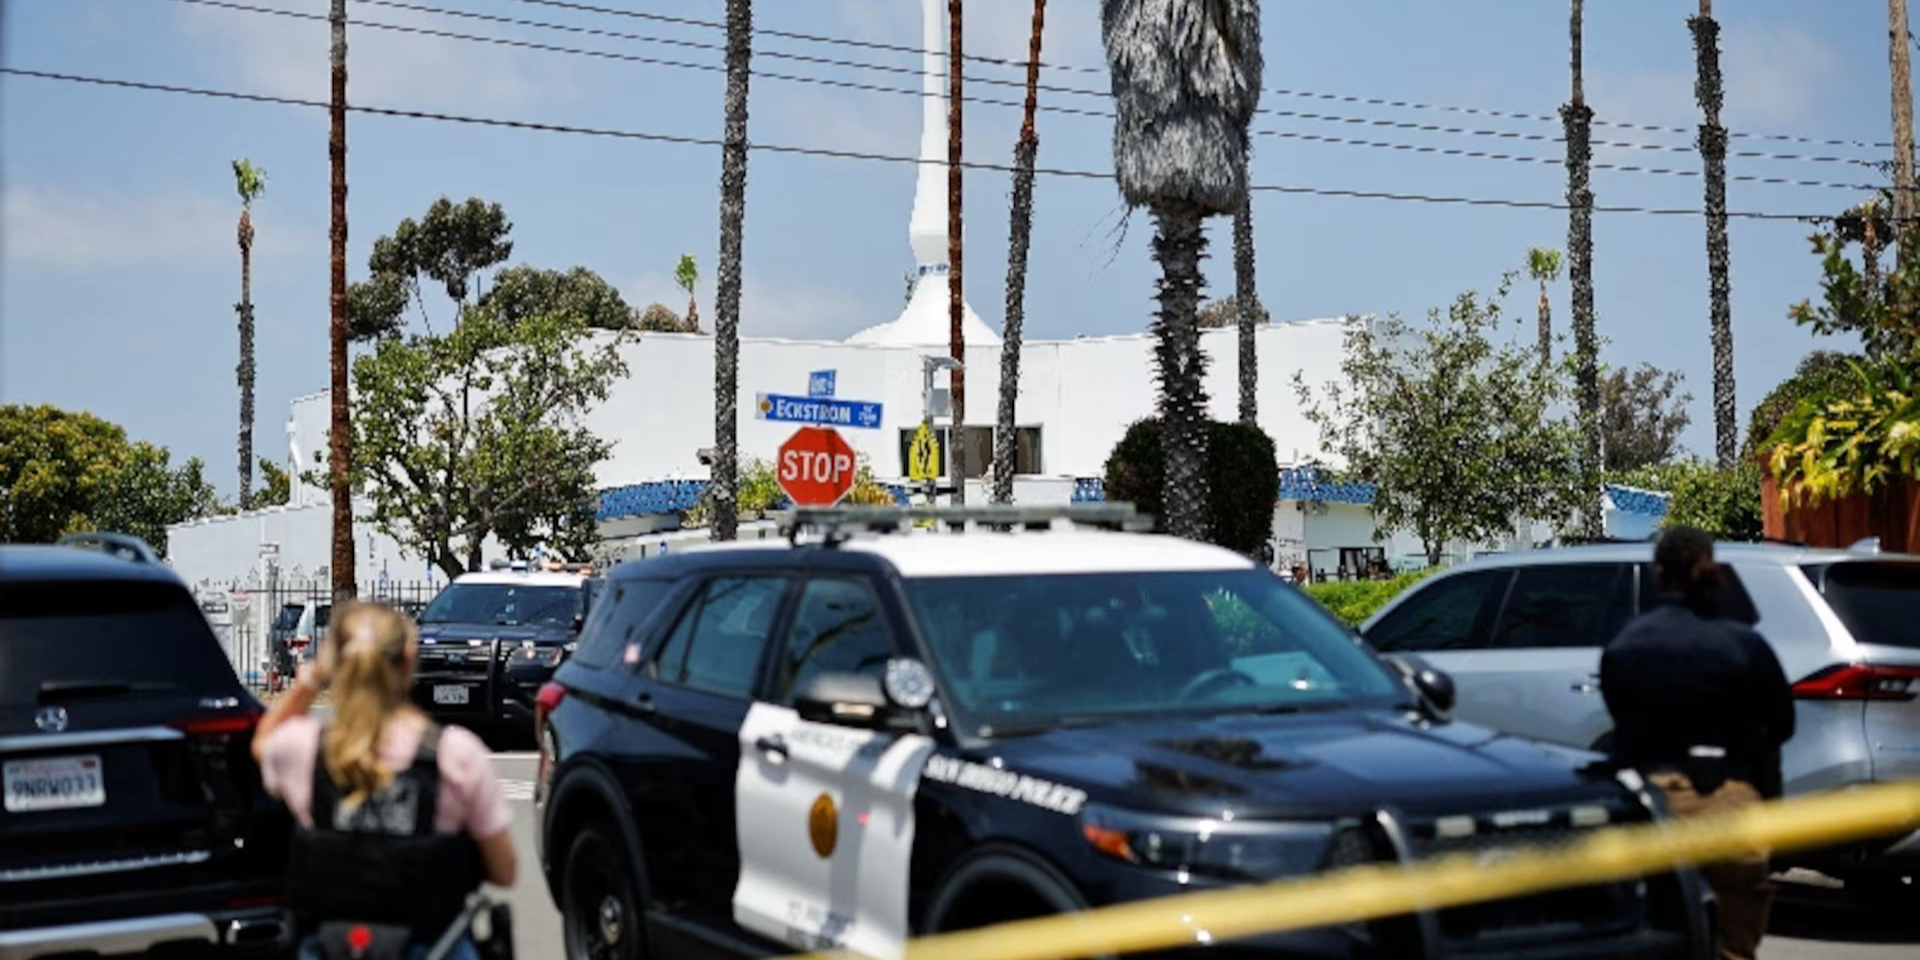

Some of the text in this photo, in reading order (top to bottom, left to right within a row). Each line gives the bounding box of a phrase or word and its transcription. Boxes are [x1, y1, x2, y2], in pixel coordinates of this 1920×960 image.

[776, 399, 851, 423] ECKSTROM
[781, 450, 851, 484] STOP
[1010, 774, 1088, 816] POLICE
